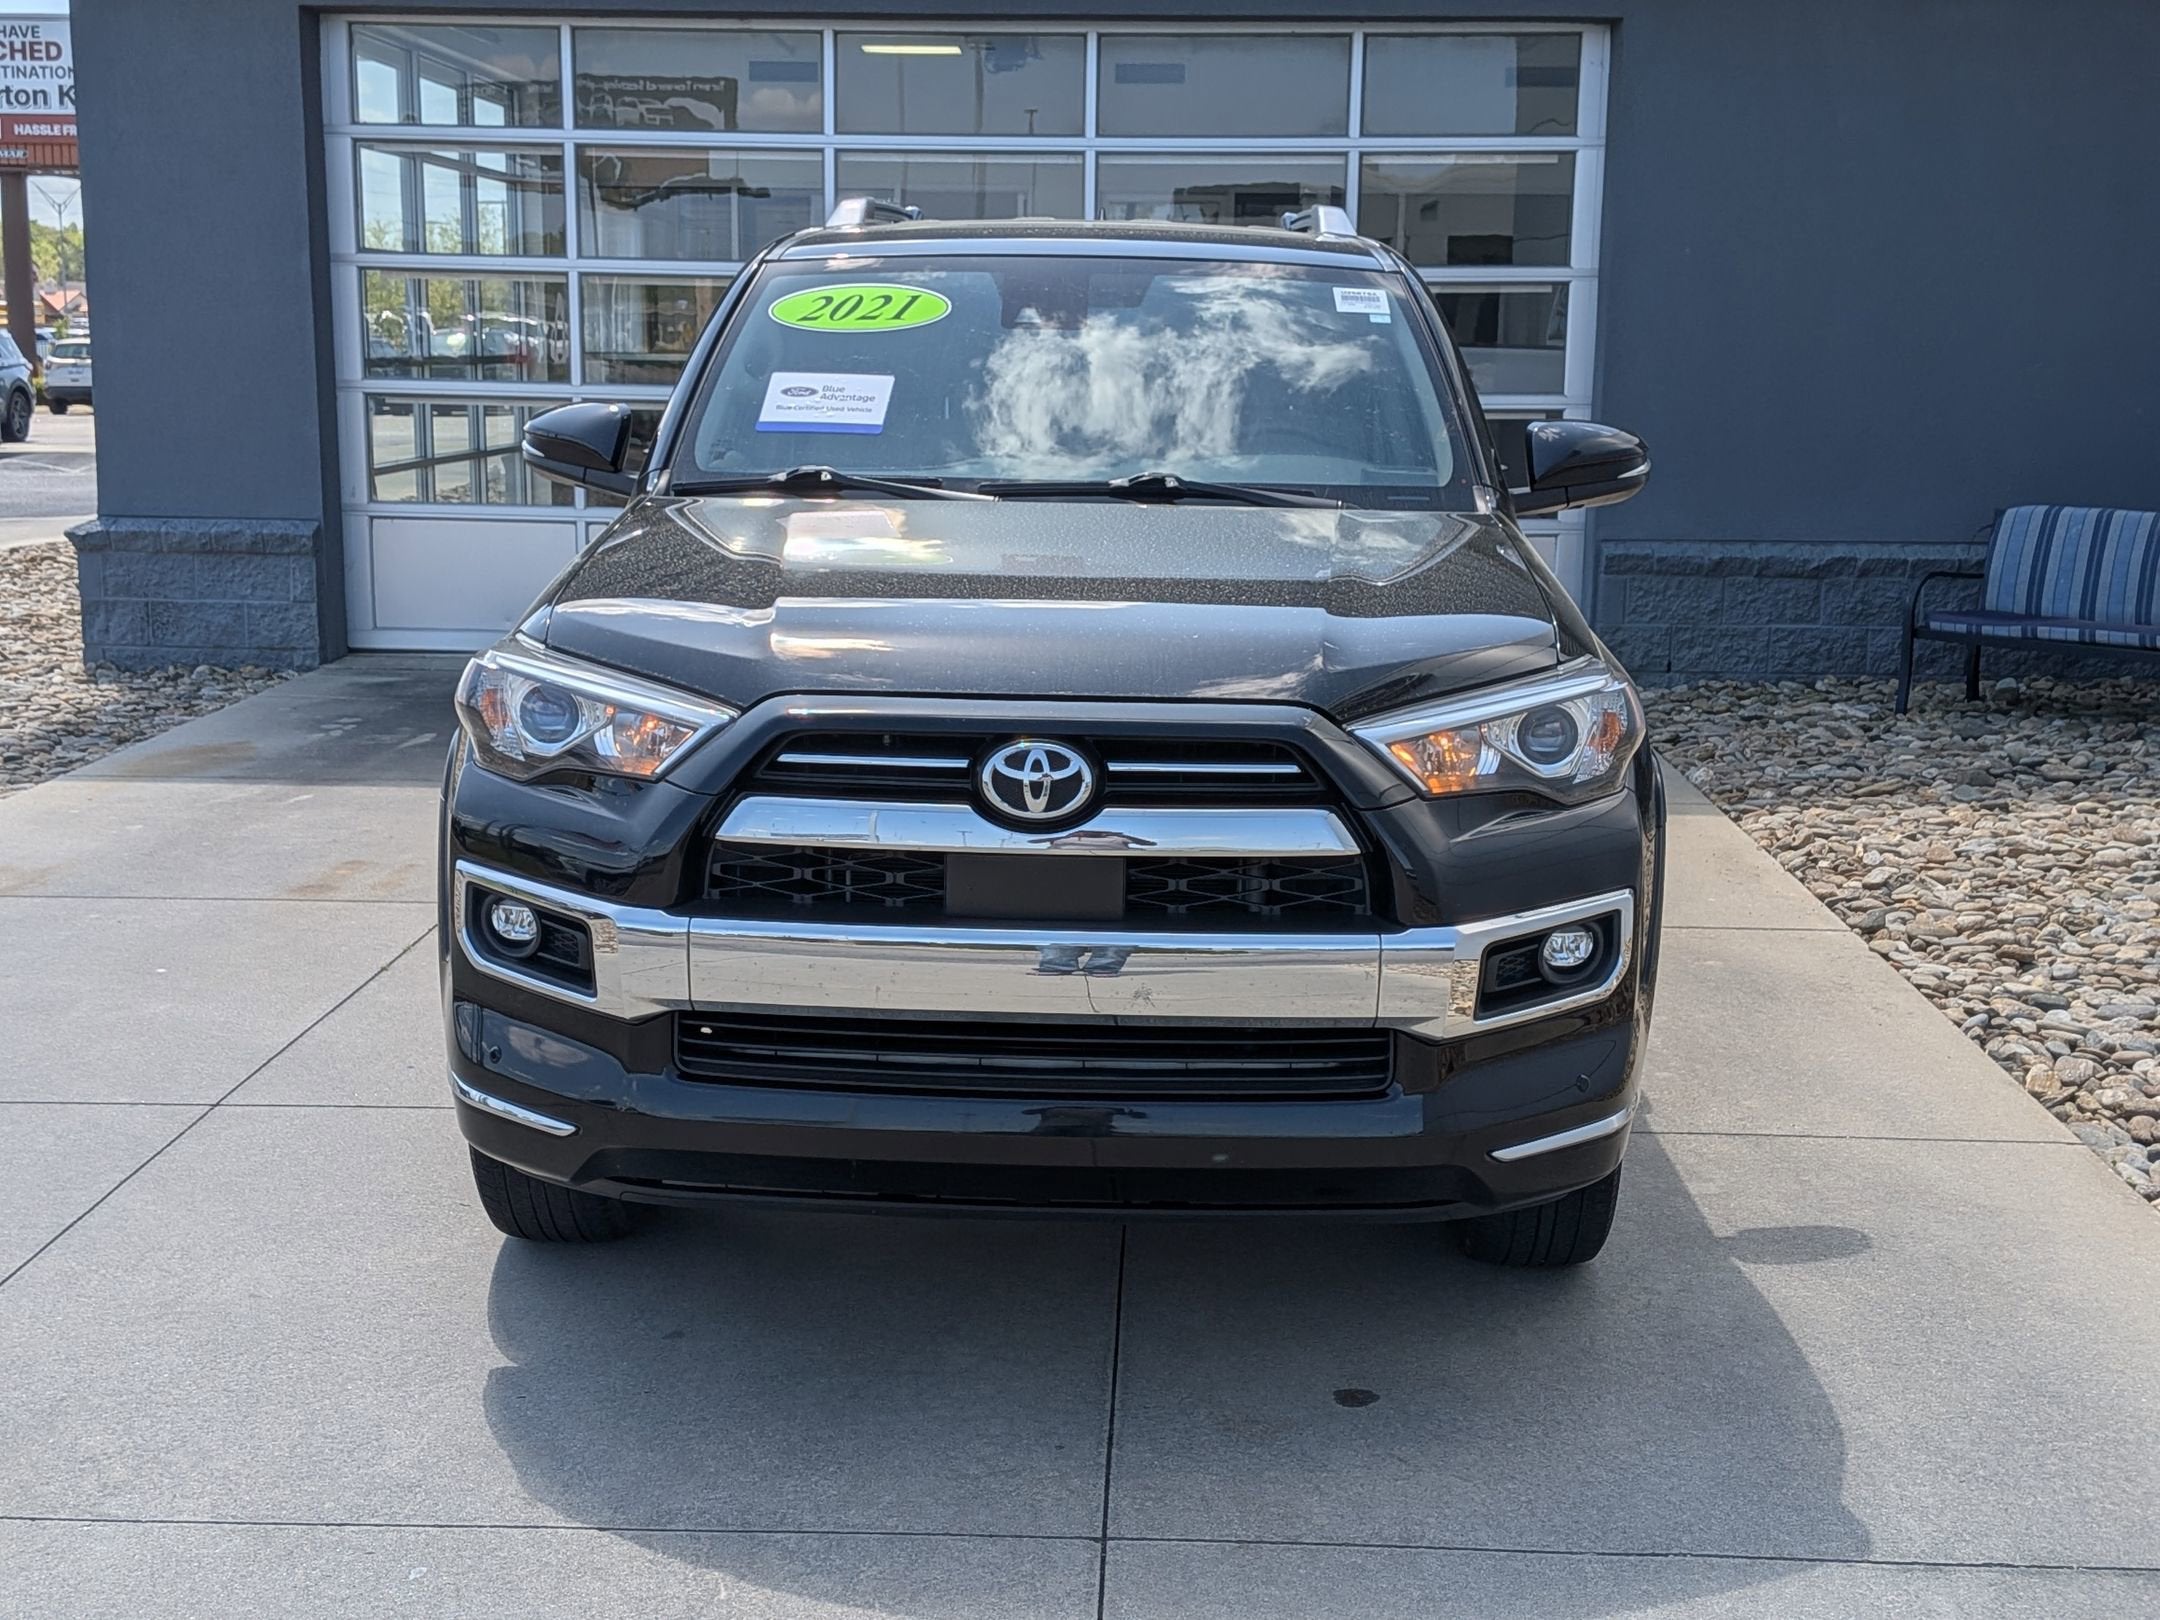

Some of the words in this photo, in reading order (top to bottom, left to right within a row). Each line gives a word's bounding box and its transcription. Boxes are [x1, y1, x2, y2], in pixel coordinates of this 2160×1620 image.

[14, 124, 61, 136] HASSLE
[796, 294, 922, 322] 2021
[785, 387, 814, 397] Ford
[822, 385, 846, 393] Blue
[820, 393, 876, 403] Advantage
